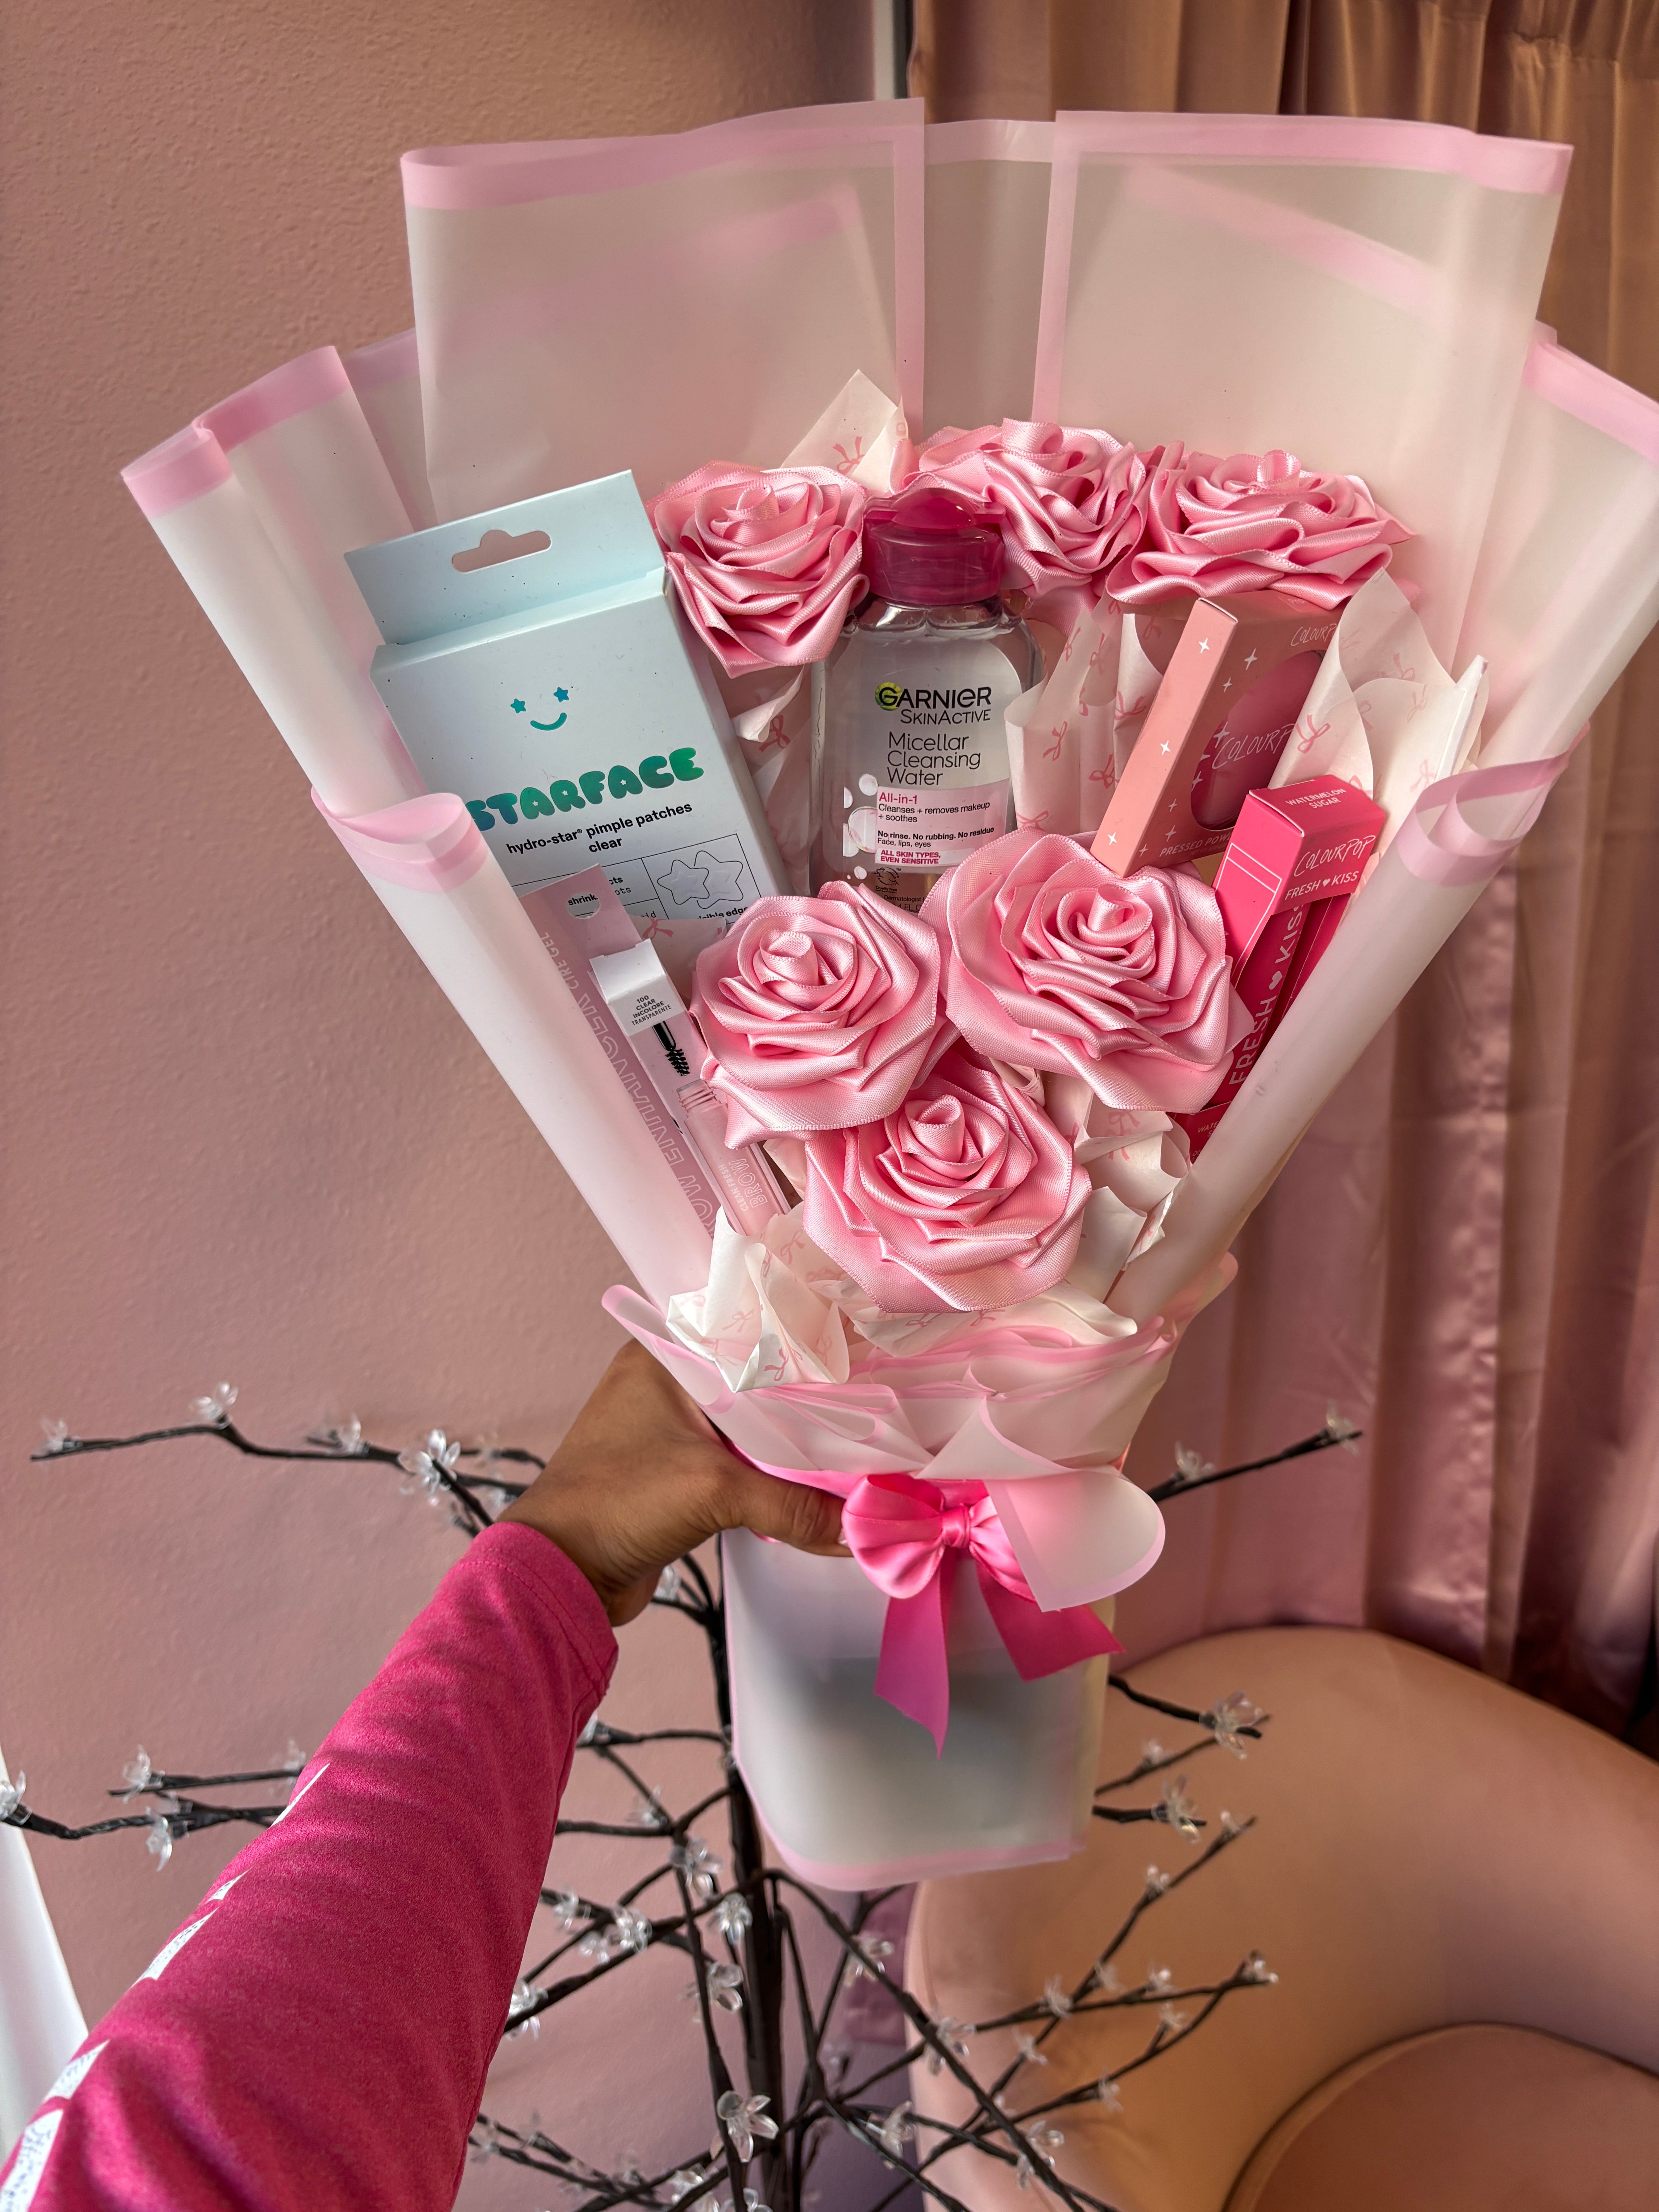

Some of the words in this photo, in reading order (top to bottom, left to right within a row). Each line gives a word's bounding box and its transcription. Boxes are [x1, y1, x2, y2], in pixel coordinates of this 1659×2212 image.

[1291, 623, 1337, 646] COLOURP
[879, 687, 991, 709] GARNIER
[889, 732, 969, 751] Micellar
[1212, 723, 1295, 769] COLOURP
[888, 750, 981, 769] Cleansing
[887, 767, 943, 785] Water
[465, 747, 704, 831] STARFACE
[879, 792, 917, 804] All-in-1
[1286, 788, 1346, 806] WATERMELON
[879, 804, 915, 814] Cleanses
[961, 802, 990, 812] makeup
[1309, 797, 1341, 808] SUGAR
[586, 817, 634, 839] pimple
[635, 802, 692, 827] patches
[886, 814, 917, 823] soothes
[970, 827, 994, 836] residue
[589, 837, 623, 853] clear
[878, 838, 896, 846] Face,
[1159, 840, 1203, 857] PRESSED
[1294, 835, 1376, 877] COLOURPOP
[1285, 880, 1321, 901] FRESH
[1331, 871, 1359, 886] KISS
[568, 894, 598, 905] shrink
[541, 933, 560, 958] GEL
[636, 999, 656, 1010] CLEAR
[637, 995, 649, 1003] 100
[631, 1004, 672, 1025] TRANSPARENTE
[633, 1001, 665, 1018] INCOLORE
[1229, 994, 1277, 1084] FRESH
[718, 1164, 735, 1187] FRESH
[728, 1159, 768, 1208] BROW
[732, 1188, 749, 1211] CLEAN
